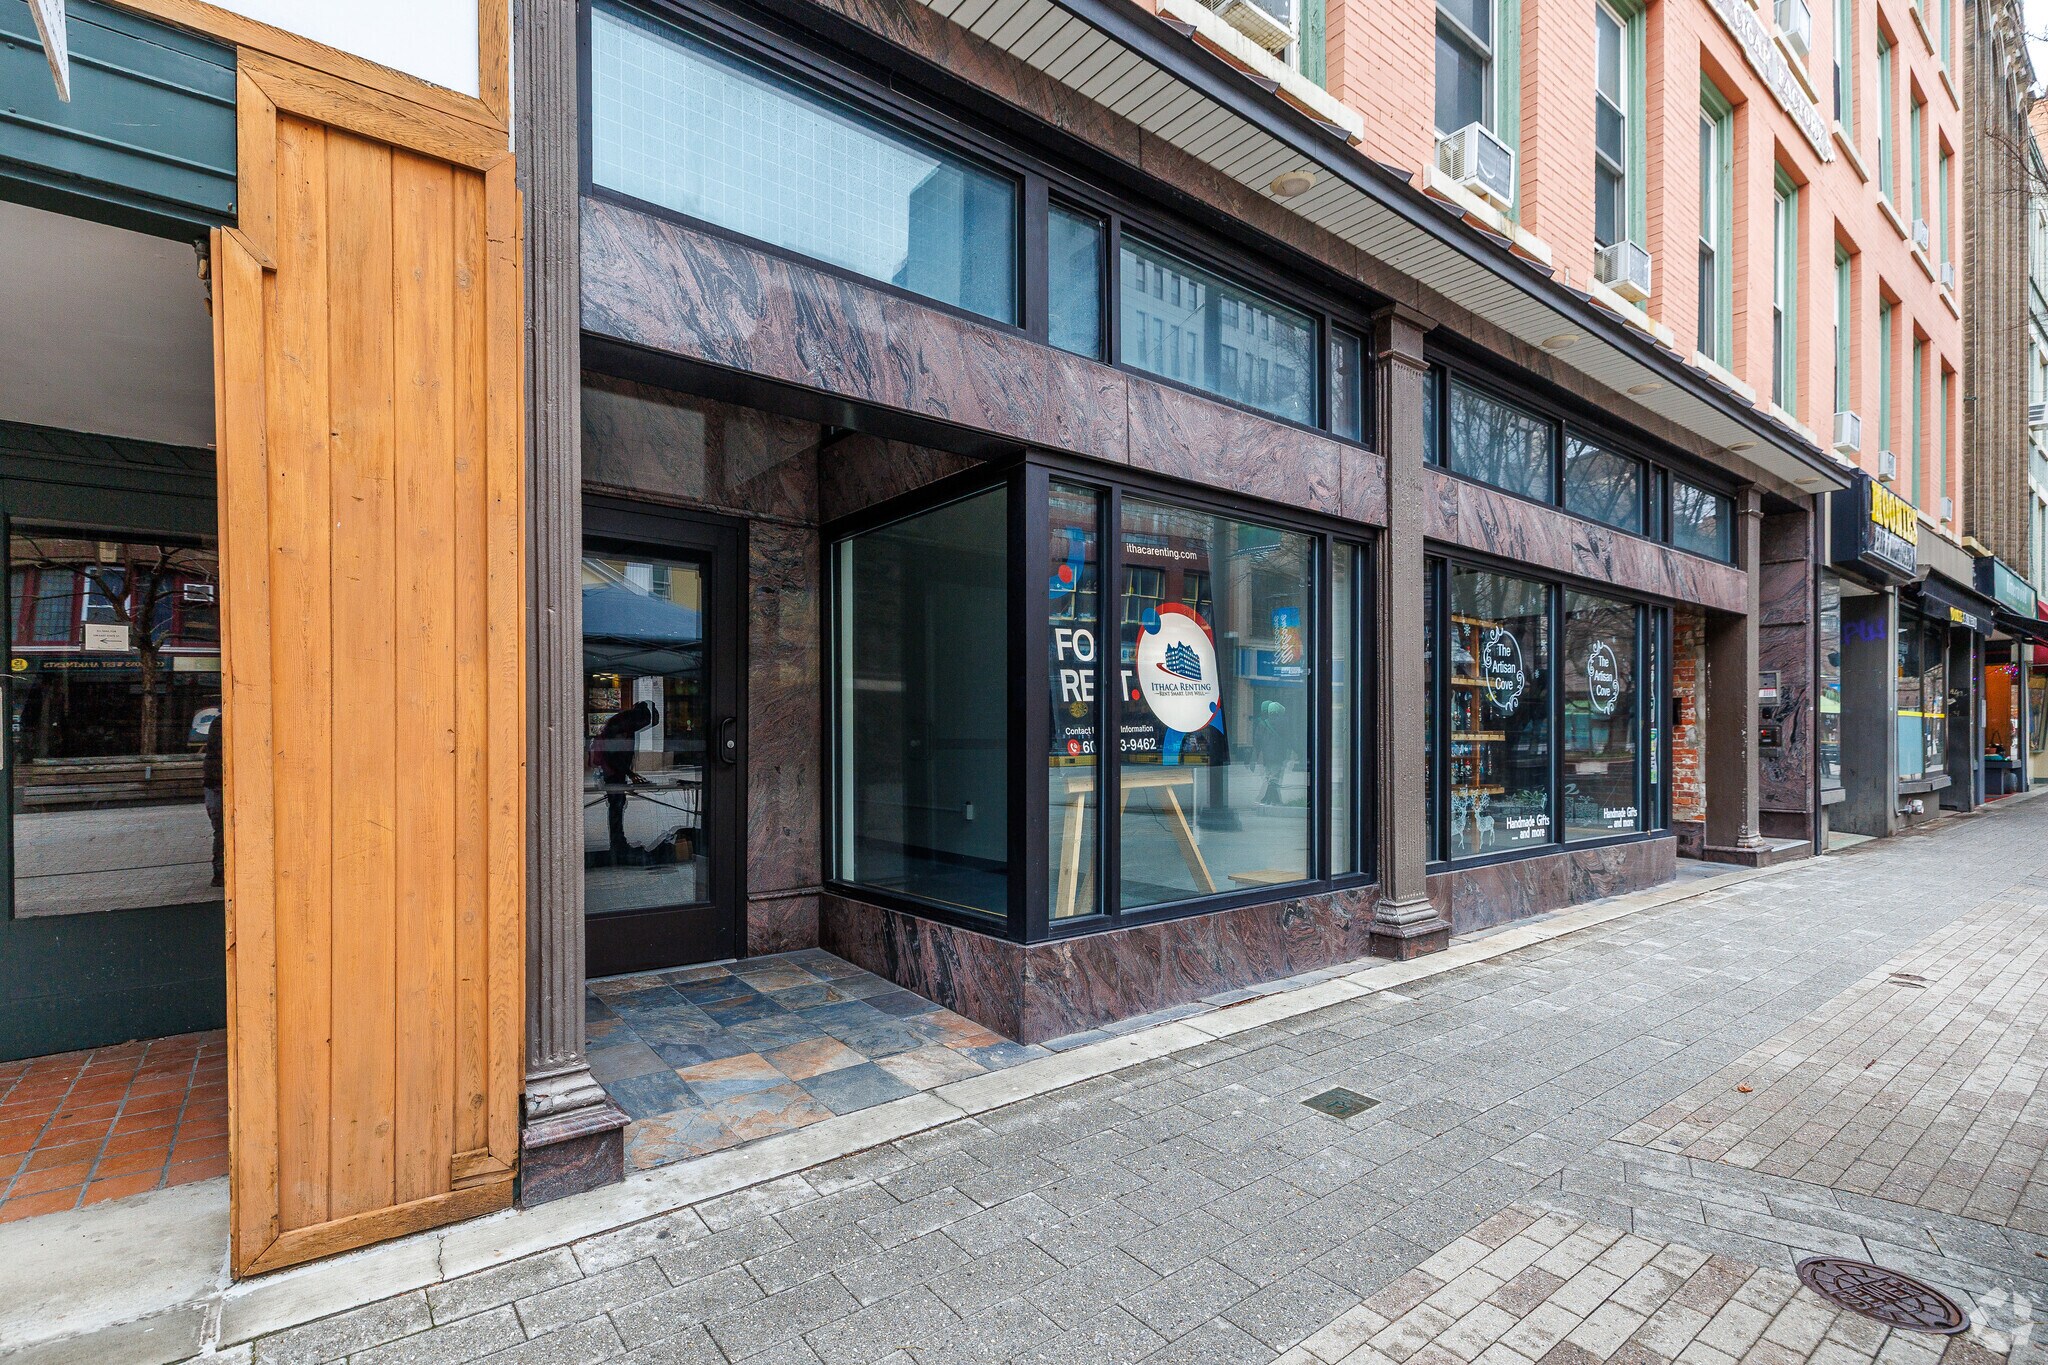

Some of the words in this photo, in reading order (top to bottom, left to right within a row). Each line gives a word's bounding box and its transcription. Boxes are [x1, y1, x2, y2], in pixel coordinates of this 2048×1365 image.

[1126, 542, 1198, 561] ithacarenting.com
[1055, 628, 1094, 662] FO
[1497, 643, 1511, 657] The
[1492, 660, 1516, 674] Artisan
[1598, 655, 1609, 668] The
[1594, 670, 1613, 682] Artisan
[1060, 668, 1141, 702] RET.
[1495, 677, 1513, 690] Cove
[1596, 684, 1611, 697] Cove
[1065, 726, 1091, 736] Contact
[1120, 724, 1154, 733] Information
[1603, 807, 1626, 819] Handmade
[1626, 806, 1638, 818] Gifts
[1506, 815, 1535, 830] Handmade
[1536, 814, 1550, 826] Gifts
[1613, 817, 1622, 828] and
[1623, 819, 1634, 828] more
[1520, 827, 1530, 839] and
[1531, 829, 1545, 838] more
